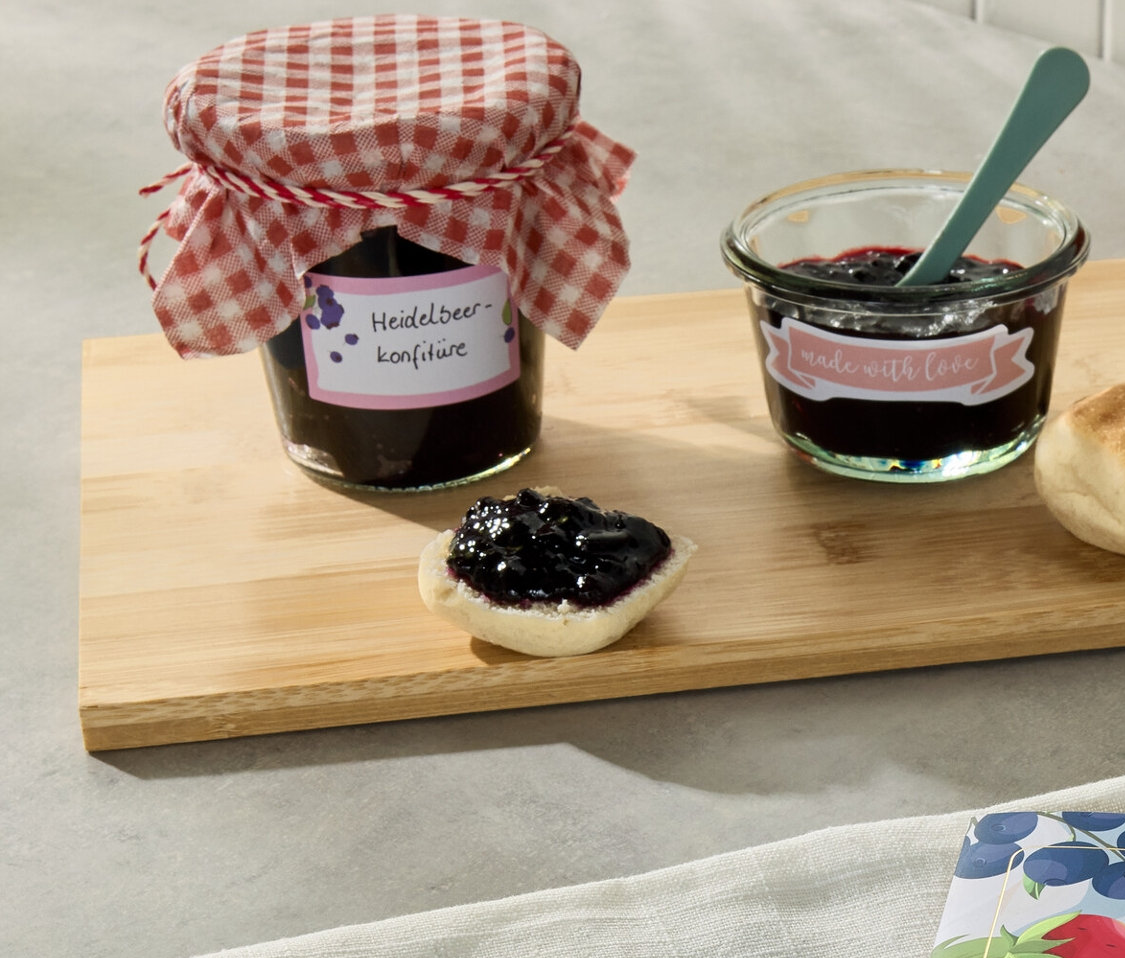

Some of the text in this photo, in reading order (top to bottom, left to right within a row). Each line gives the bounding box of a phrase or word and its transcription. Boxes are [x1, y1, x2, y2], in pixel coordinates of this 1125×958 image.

[371, 302, 493, 332] Heidelbeer-
[377, 338, 468, 370] konfitüre
[801, 348, 979, 383] made with love
